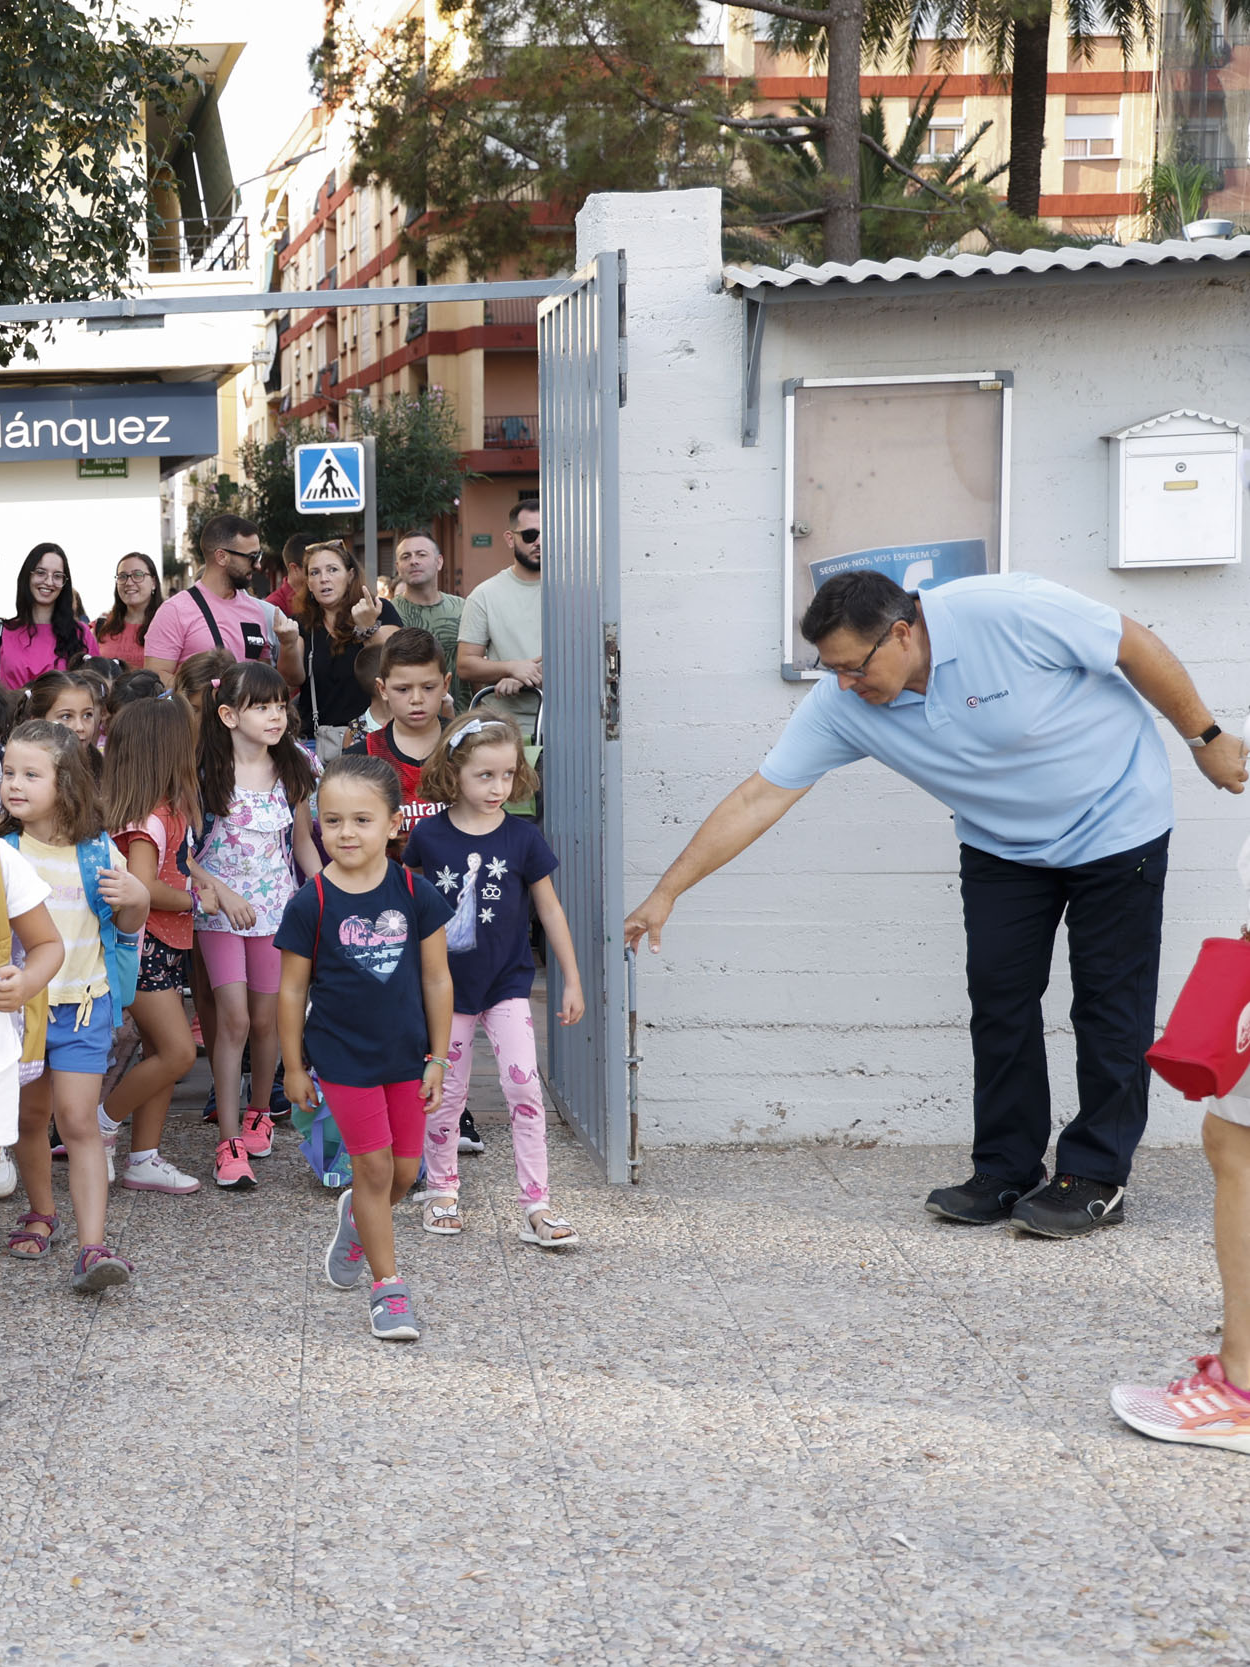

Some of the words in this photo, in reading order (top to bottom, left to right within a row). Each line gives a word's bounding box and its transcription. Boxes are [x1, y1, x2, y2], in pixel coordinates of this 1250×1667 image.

[819, 557, 873, 576] SEGUIX-NOS,
[874, 554, 892, 564] VOS
[893, 551, 930, 562] ESPEREM
[978, 689, 1009, 704] Nemasa
[481, 887, 501, 898] 100
